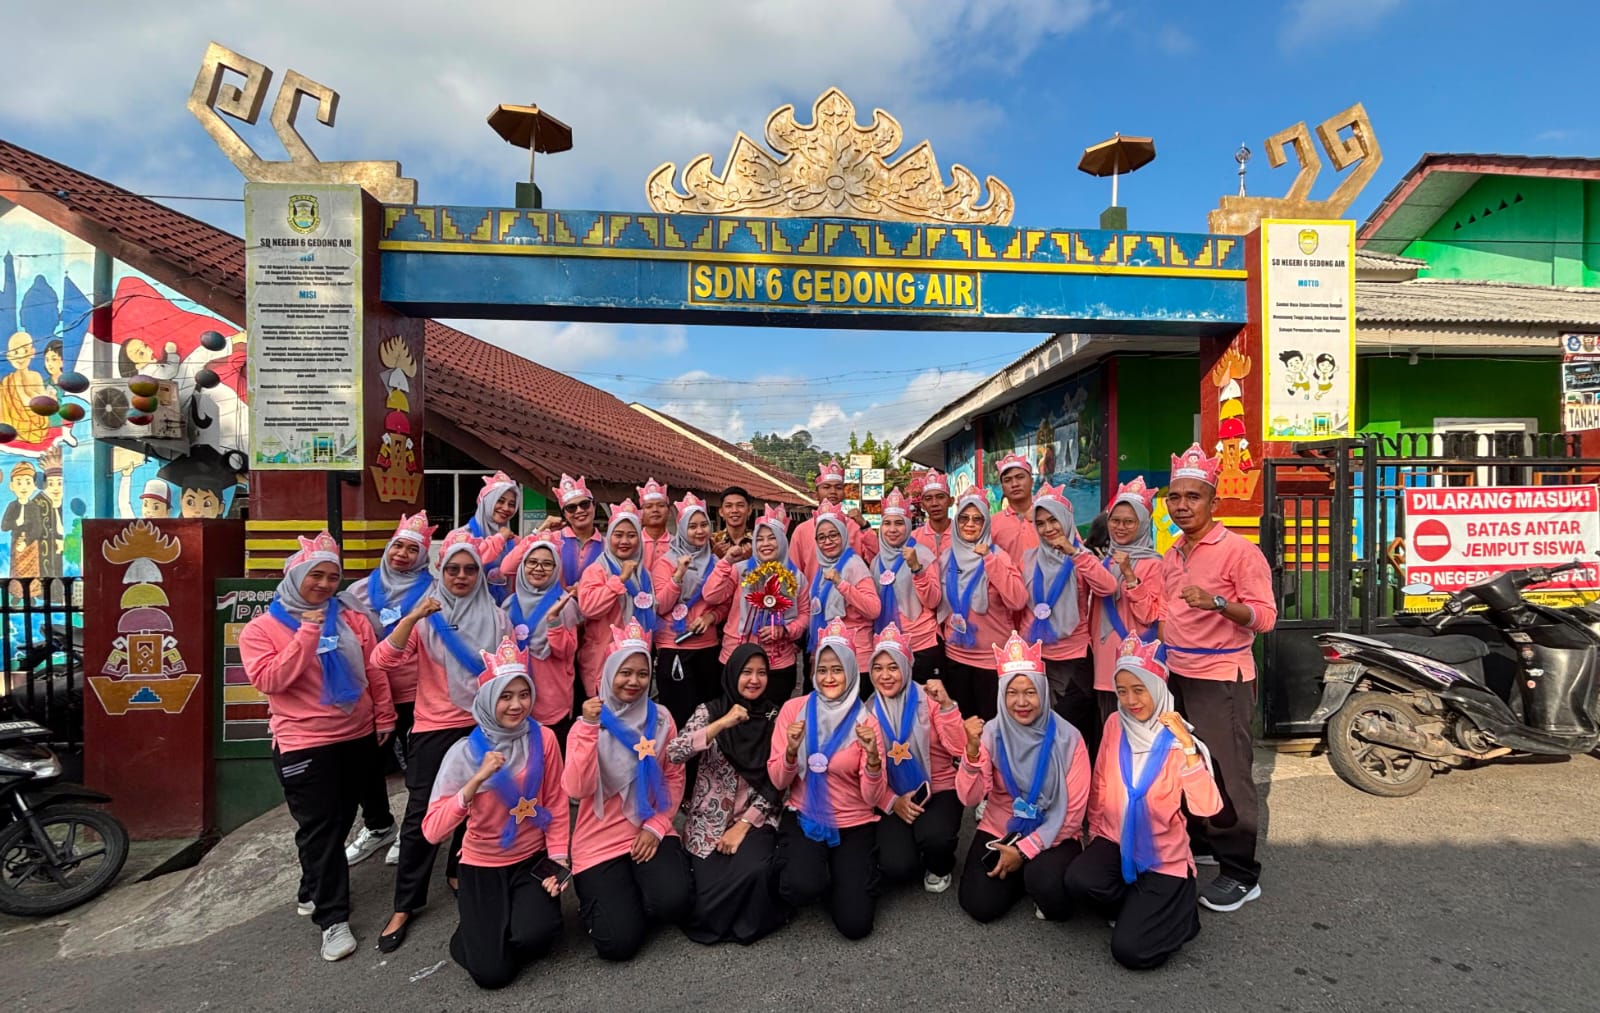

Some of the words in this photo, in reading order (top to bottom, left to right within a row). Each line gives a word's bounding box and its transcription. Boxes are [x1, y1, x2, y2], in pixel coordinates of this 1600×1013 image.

[273, 238, 299, 247] NEGERI
[300, 239, 306, 247] 6
[307, 239, 337, 247] GEDONG
[339, 239, 352, 247] AIR
[694, 265, 755, 299] SDN
[766, 267, 783, 300] 6
[792, 269, 915, 304] GEDONG
[924, 273, 974, 306] AIR
[299, 290, 316, 299] MISI
[1412, 493, 1512, 510] DILARANG
[1514, 490, 1591, 509] MASUK!
[1466, 522, 1521, 537] BATAS
[1524, 520, 1581, 536] ANTAR
[1462, 541, 1528, 558] JEMPUT
[1532, 540, 1586, 556] SISWA
[1410, 571, 1432, 584] SD
